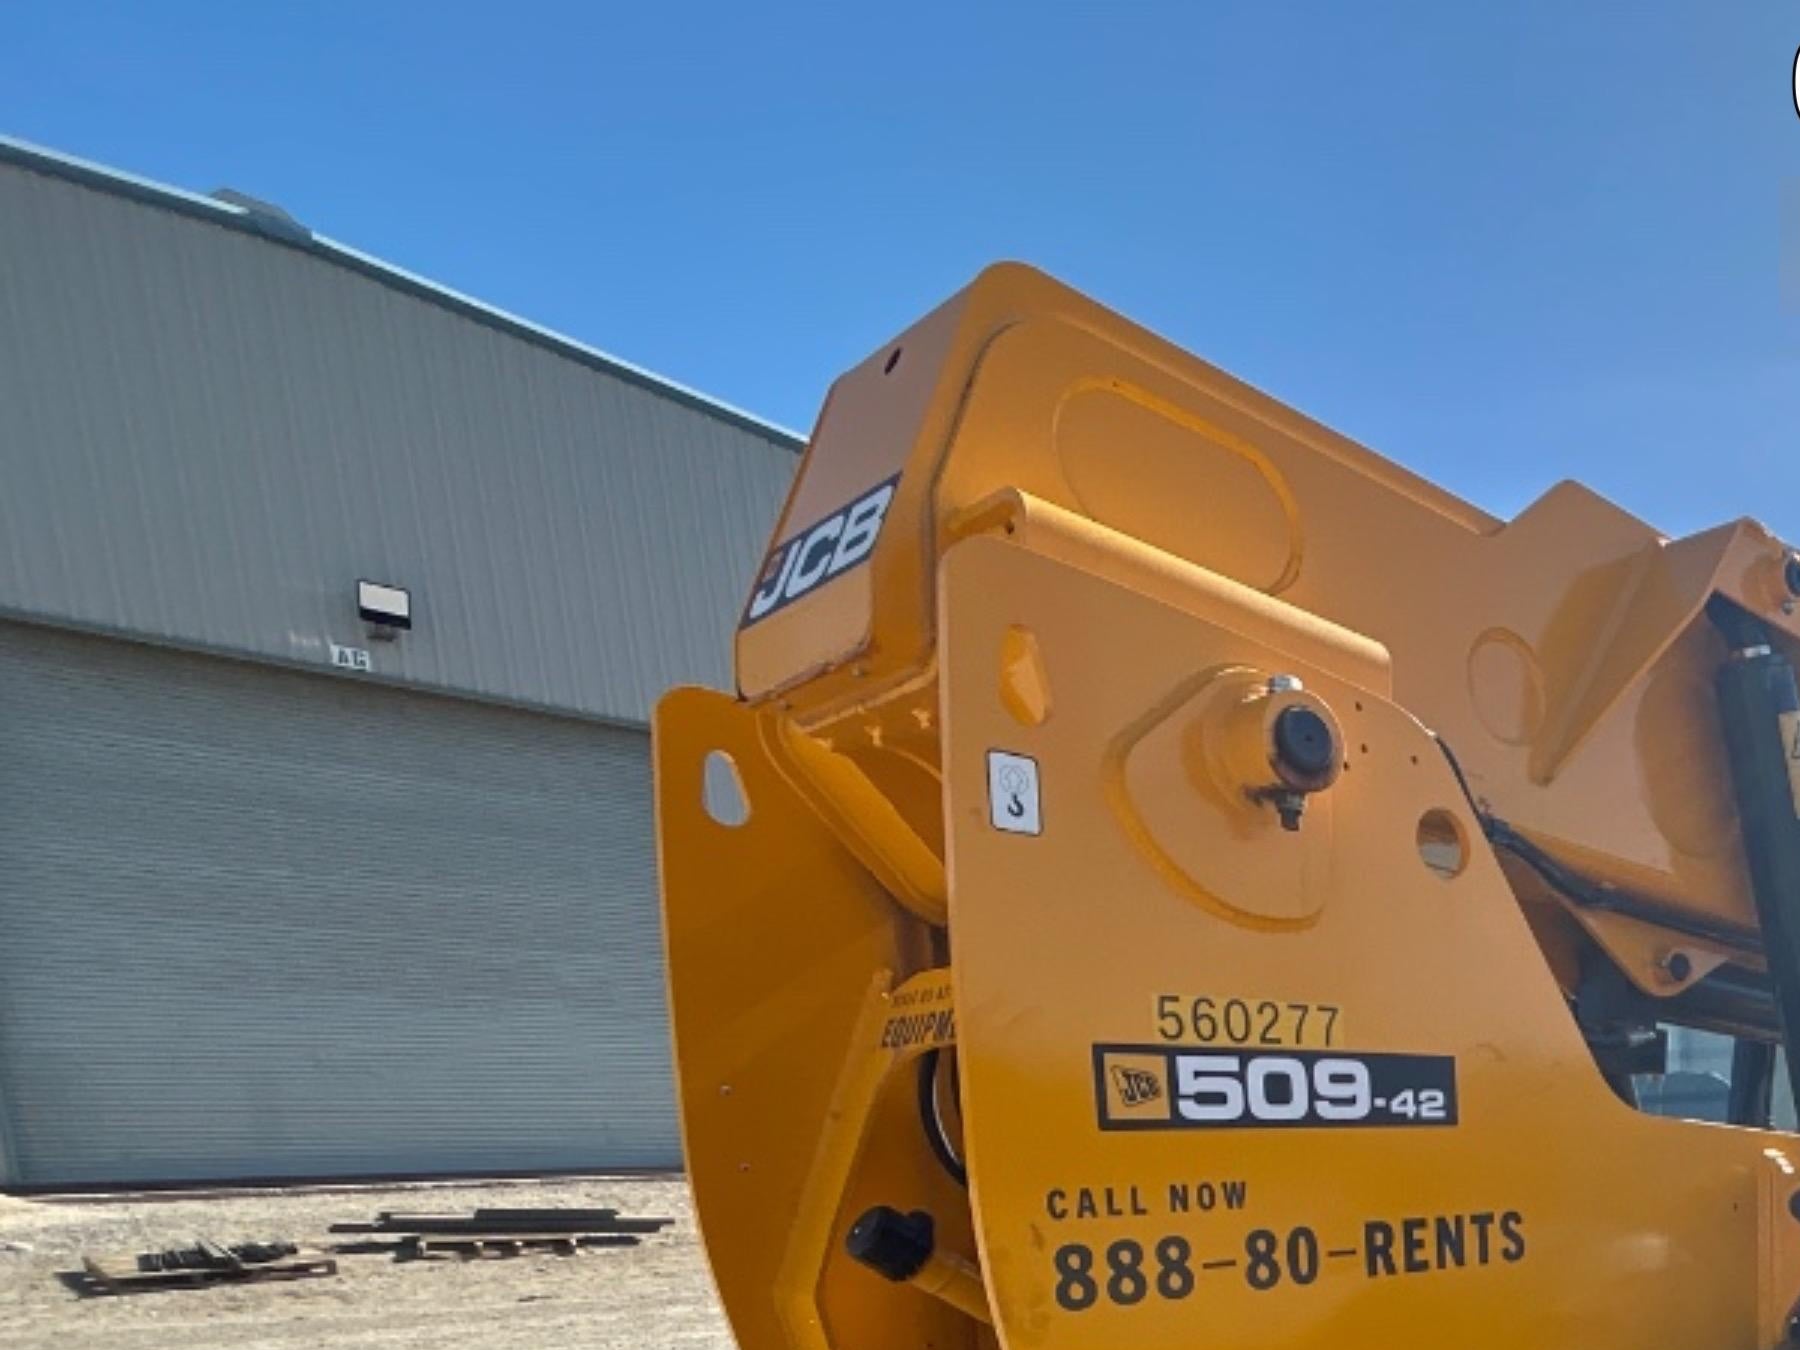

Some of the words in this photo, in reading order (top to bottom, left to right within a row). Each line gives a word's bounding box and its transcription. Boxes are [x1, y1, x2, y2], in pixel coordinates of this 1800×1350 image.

[749, 484, 894, 620] JCB
[1156, 995, 1339, 1046] 560277
[1175, 1054, 1447, 1121] 509-42
[1046, 1187, 1149, 1220] CALL
[1169, 1181, 1247, 1213] NOW
[1053, 1210, 1526, 1312] 888-80-RENTS
